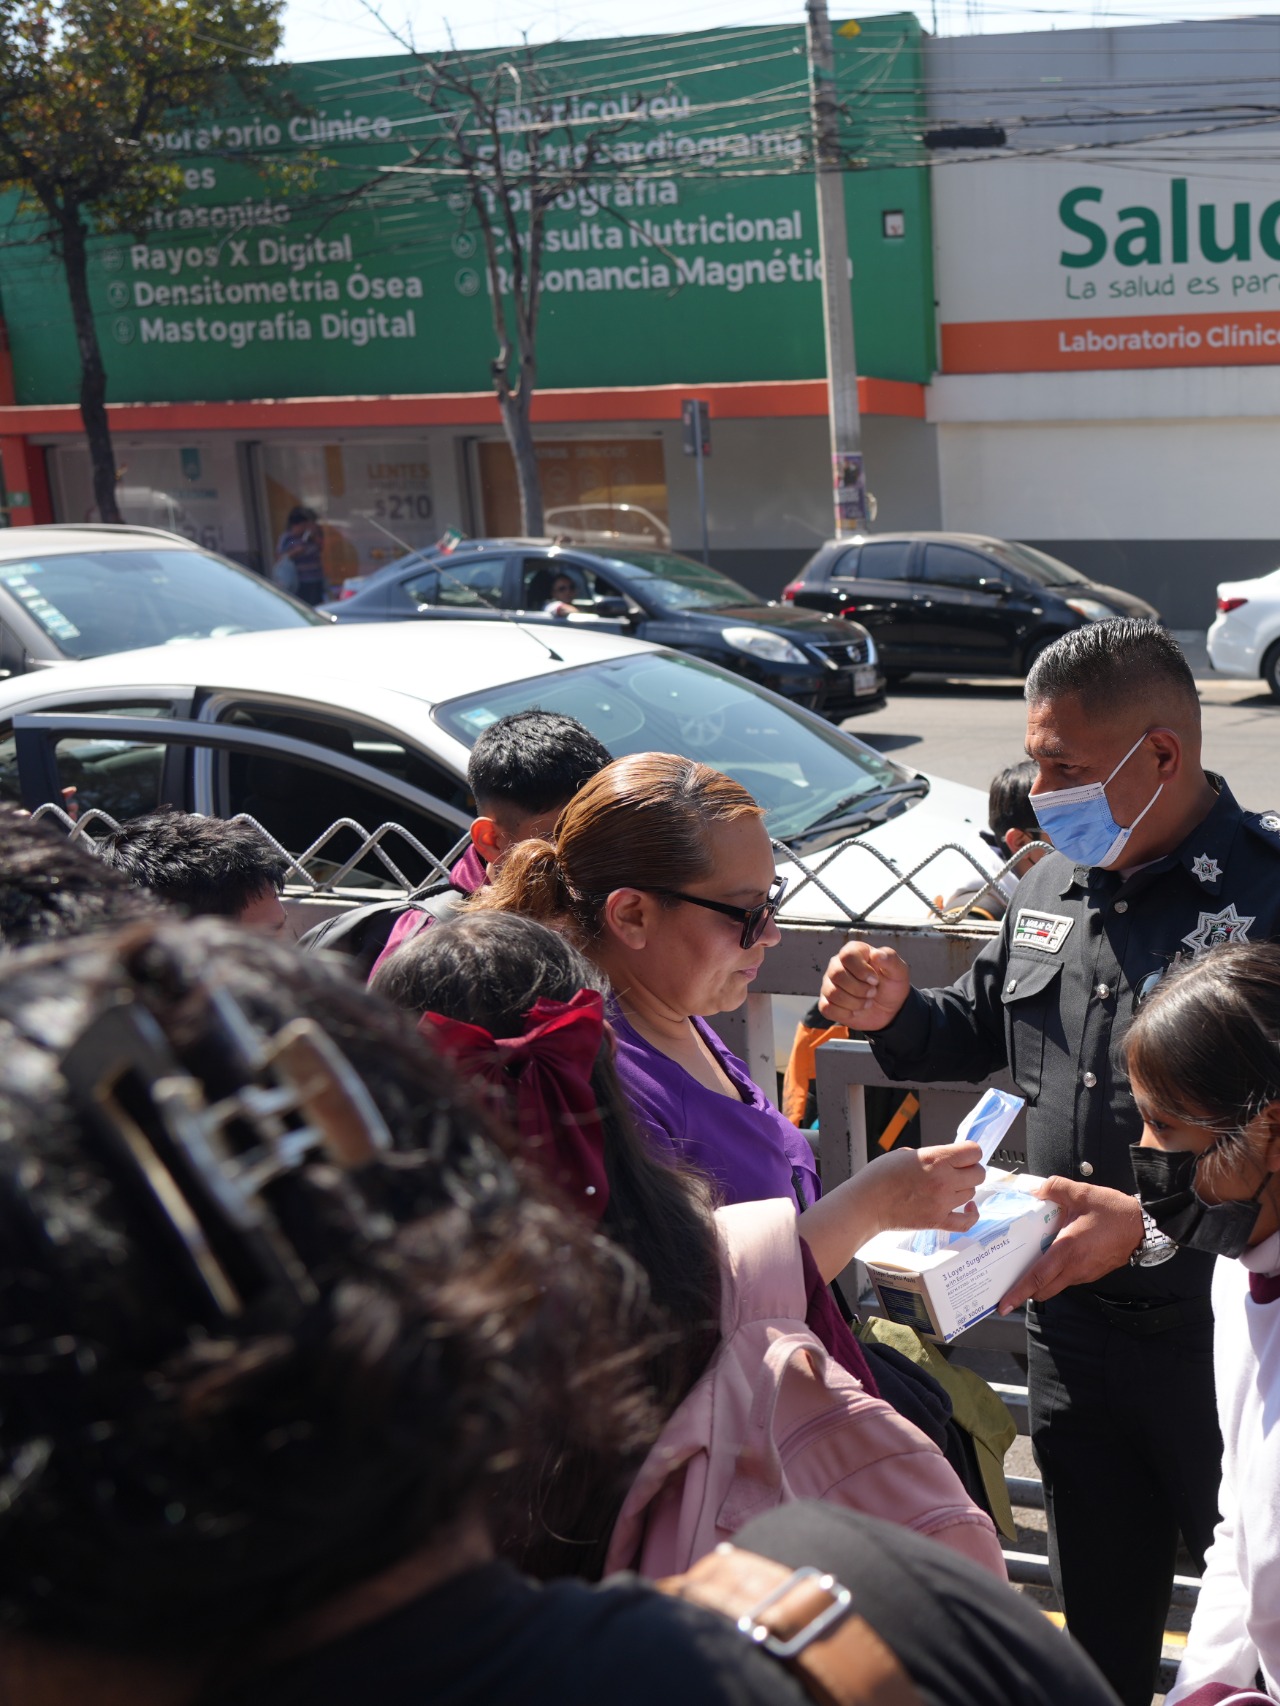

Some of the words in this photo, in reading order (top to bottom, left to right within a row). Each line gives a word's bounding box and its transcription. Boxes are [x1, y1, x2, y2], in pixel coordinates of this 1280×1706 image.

[288, 110, 392, 142] Clínico
[144, 198, 291, 231] trasonido
[629, 209, 803, 249] Nutricional
[130, 244, 219, 275] Rayos
[229, 240, 250, 267] X
[258, 233, 353, 271] Digital
[486, 256, 671, 296] Reonancia
[676, 247, 854, 293] Magnétic
[134, 271, 340, 307] Densitometría
[346, 263, 423, 301] Ósea
[1066, 275, 1097, 300] La
[1108, 273, 1176, 299] salud
[1187, 277, 1220, 295] es
[140, 310, 312, 349] Mastografía
[321, 309, 416, 346] Digital
[1058, 325, 1202, 353] Laboratorio
[947, 1264, 966, 1279] Layer
[965, 1250, 991, 1268] Surgical
[990, 1238, 1011, 1254] Masks
